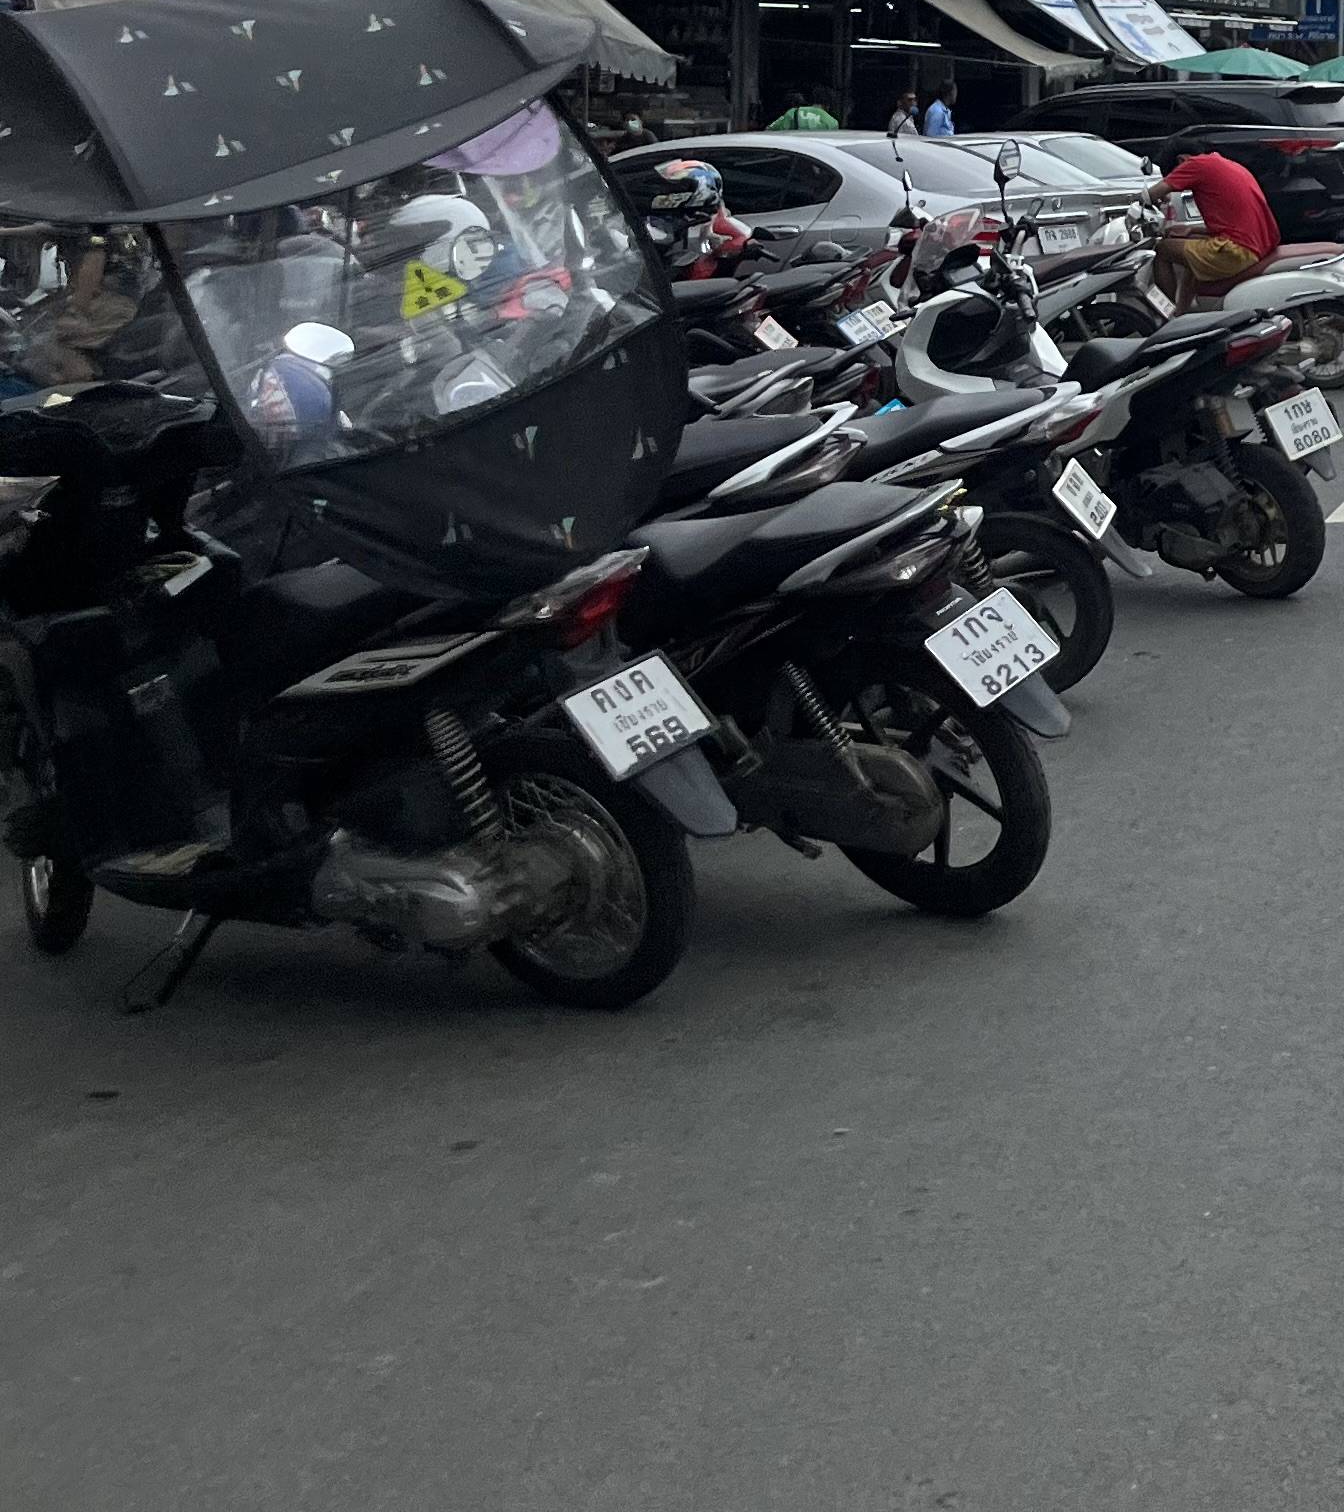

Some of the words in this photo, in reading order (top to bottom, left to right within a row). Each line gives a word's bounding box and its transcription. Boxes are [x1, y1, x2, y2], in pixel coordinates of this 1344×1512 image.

[1293, 426, 1331, 451] 8080
[952, 607, 1004, 646] 1กจ
[965, 629, 1019, 666] เชียงราย
[981, 643, 1046, 696] 8213
[626, 716, 691, 762] 569
